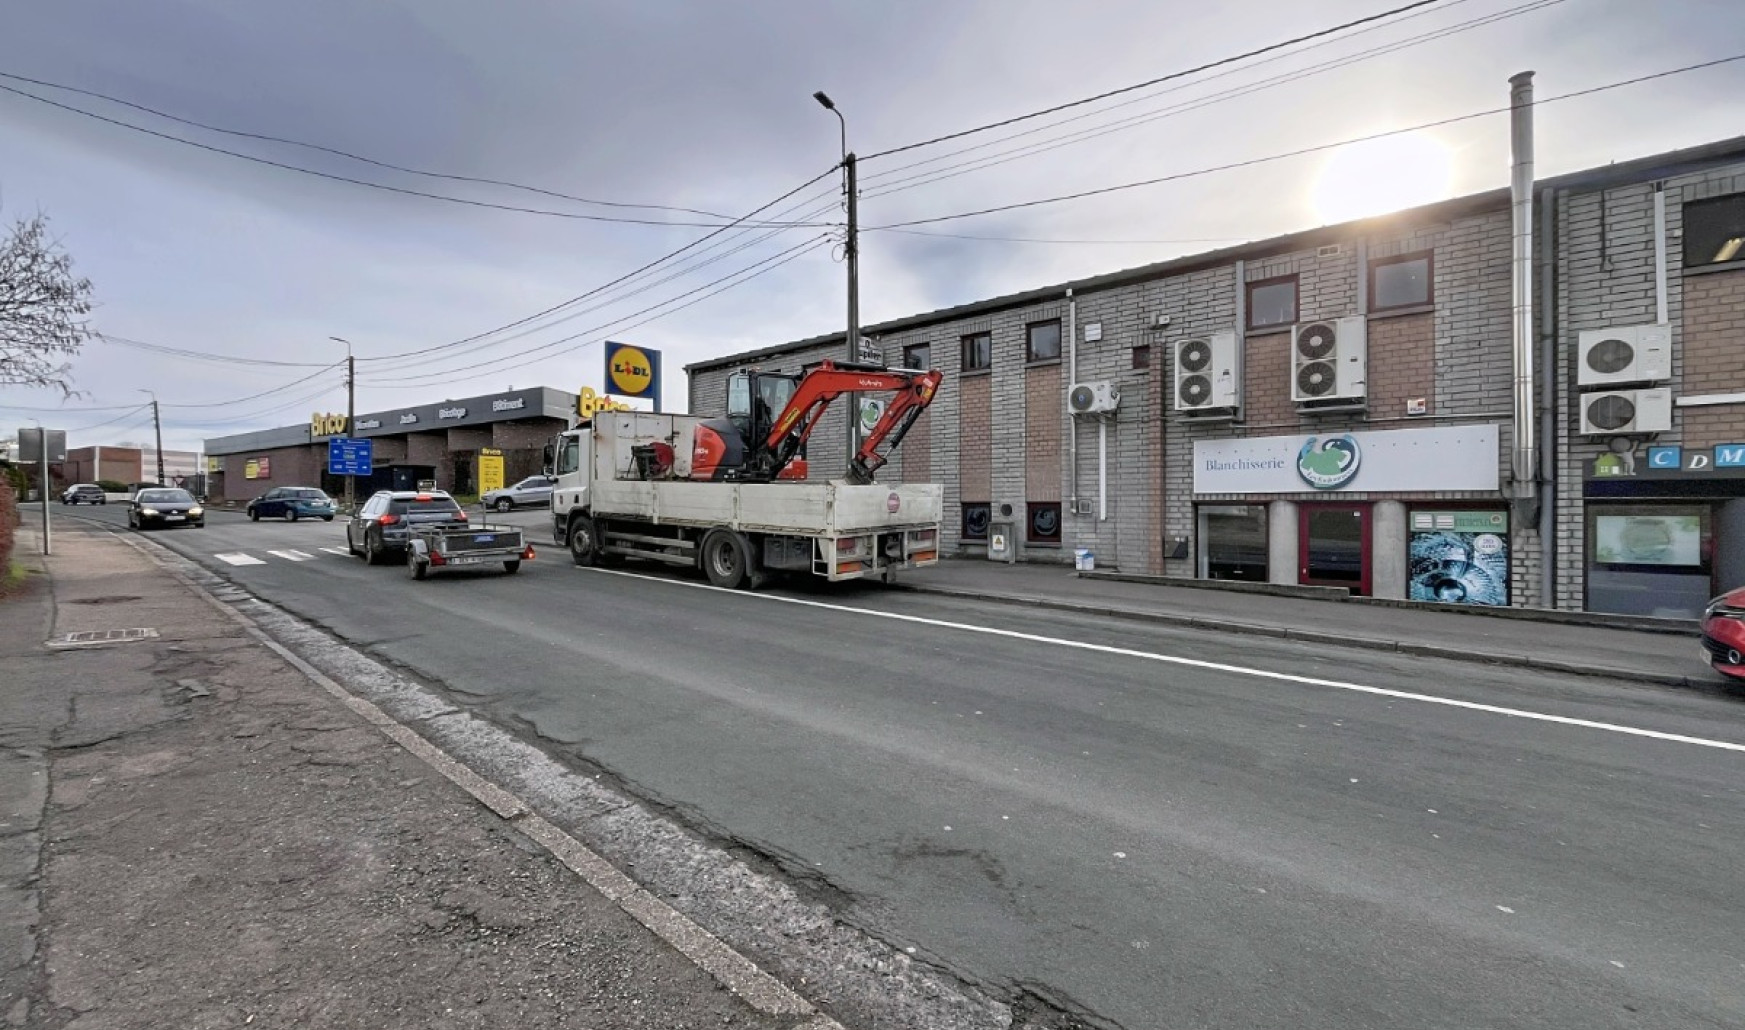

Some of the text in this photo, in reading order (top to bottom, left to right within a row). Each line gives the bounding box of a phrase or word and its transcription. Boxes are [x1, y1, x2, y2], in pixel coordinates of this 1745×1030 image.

[614, 361, 649, 377] LIDL
[312, 412, 346, 437] Brico
[1206, 457, 1285, 472] Blanchisserie
